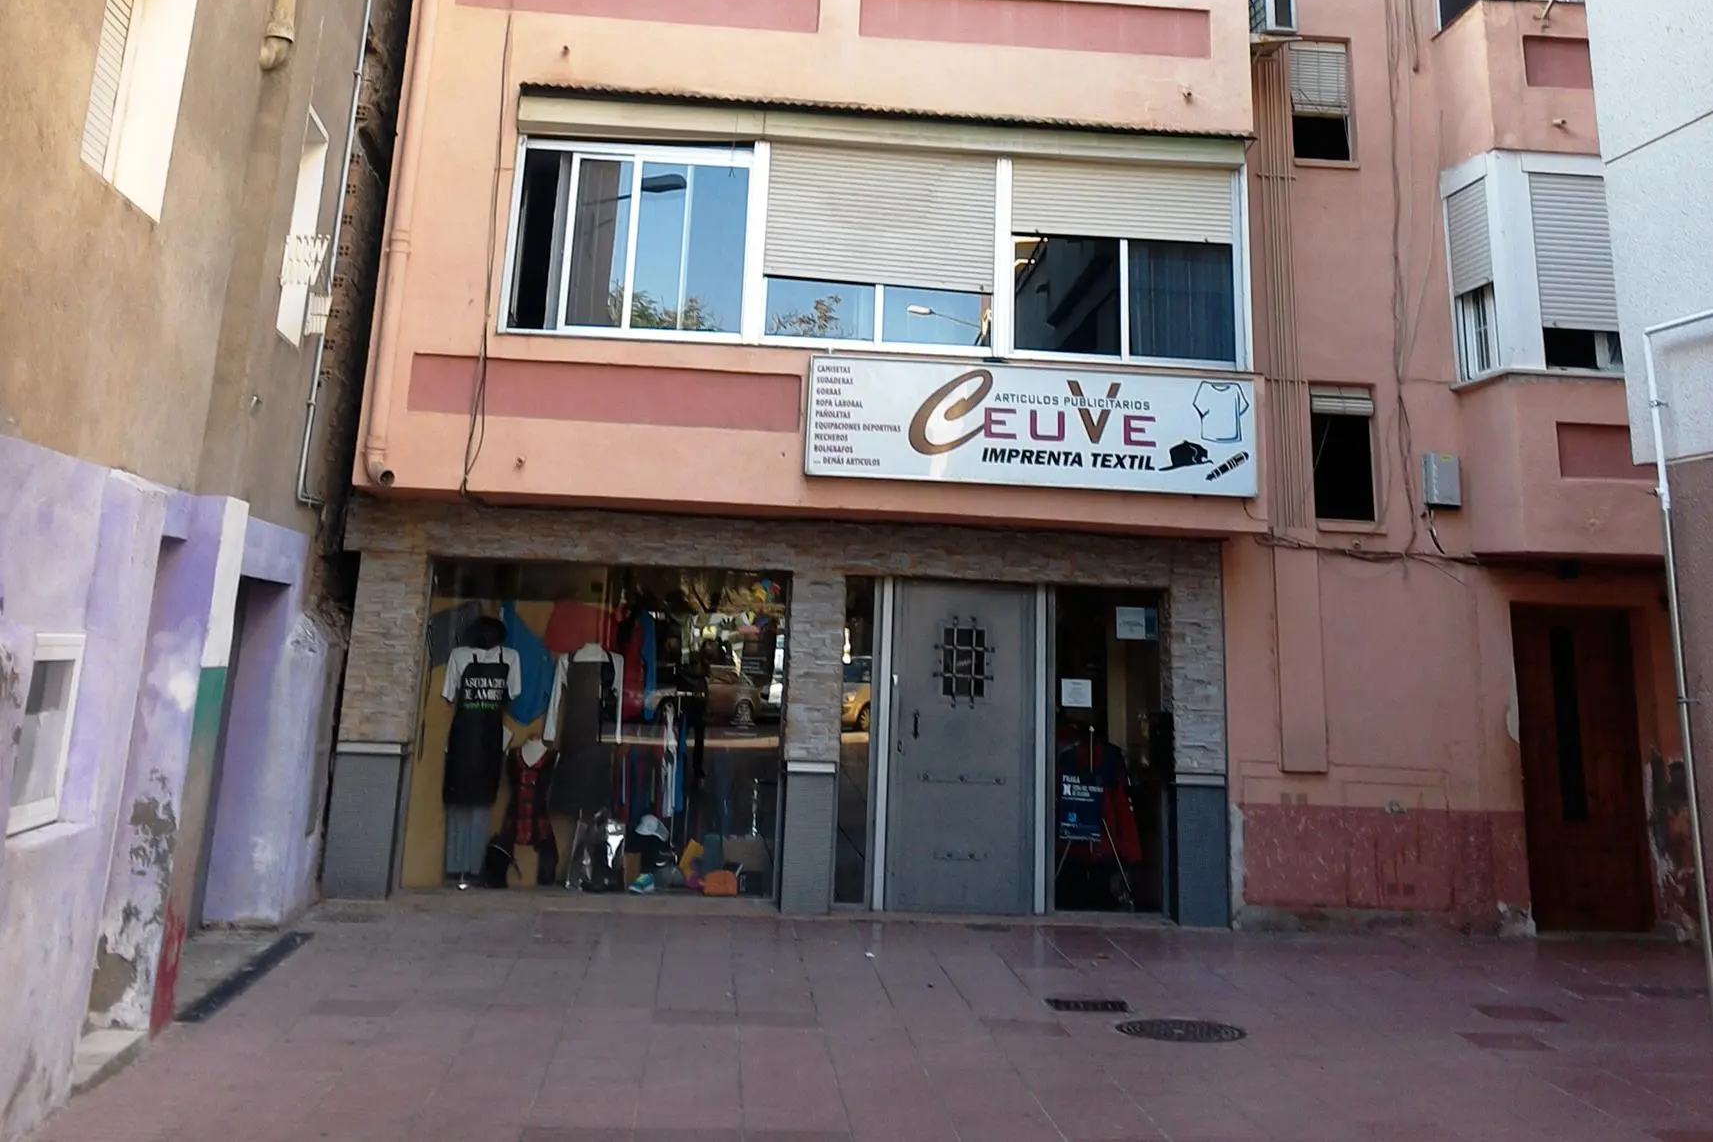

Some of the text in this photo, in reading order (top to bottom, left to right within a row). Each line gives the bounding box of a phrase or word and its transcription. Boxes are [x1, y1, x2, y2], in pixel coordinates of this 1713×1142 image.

[817, 365, 851, 374] CAMISETAS
[816, 377, 854, 385] SUDADERAS
[816, 387, 842, 396] GORRAS
[815, 398, 863, 408] ROPA LABORAL
[994, 392, 1151, 411] ARTICULOS PUBLICITARIOS
[815, 409, 851, 419] PAÑOLETAS
[815, 422, 901, 432] EQUIPACIONES DEPORTIVAS
[814, 433, 849, 442] MECHEROS
[981, 447, 1156, 472] IMPRENTA TEXTIL
